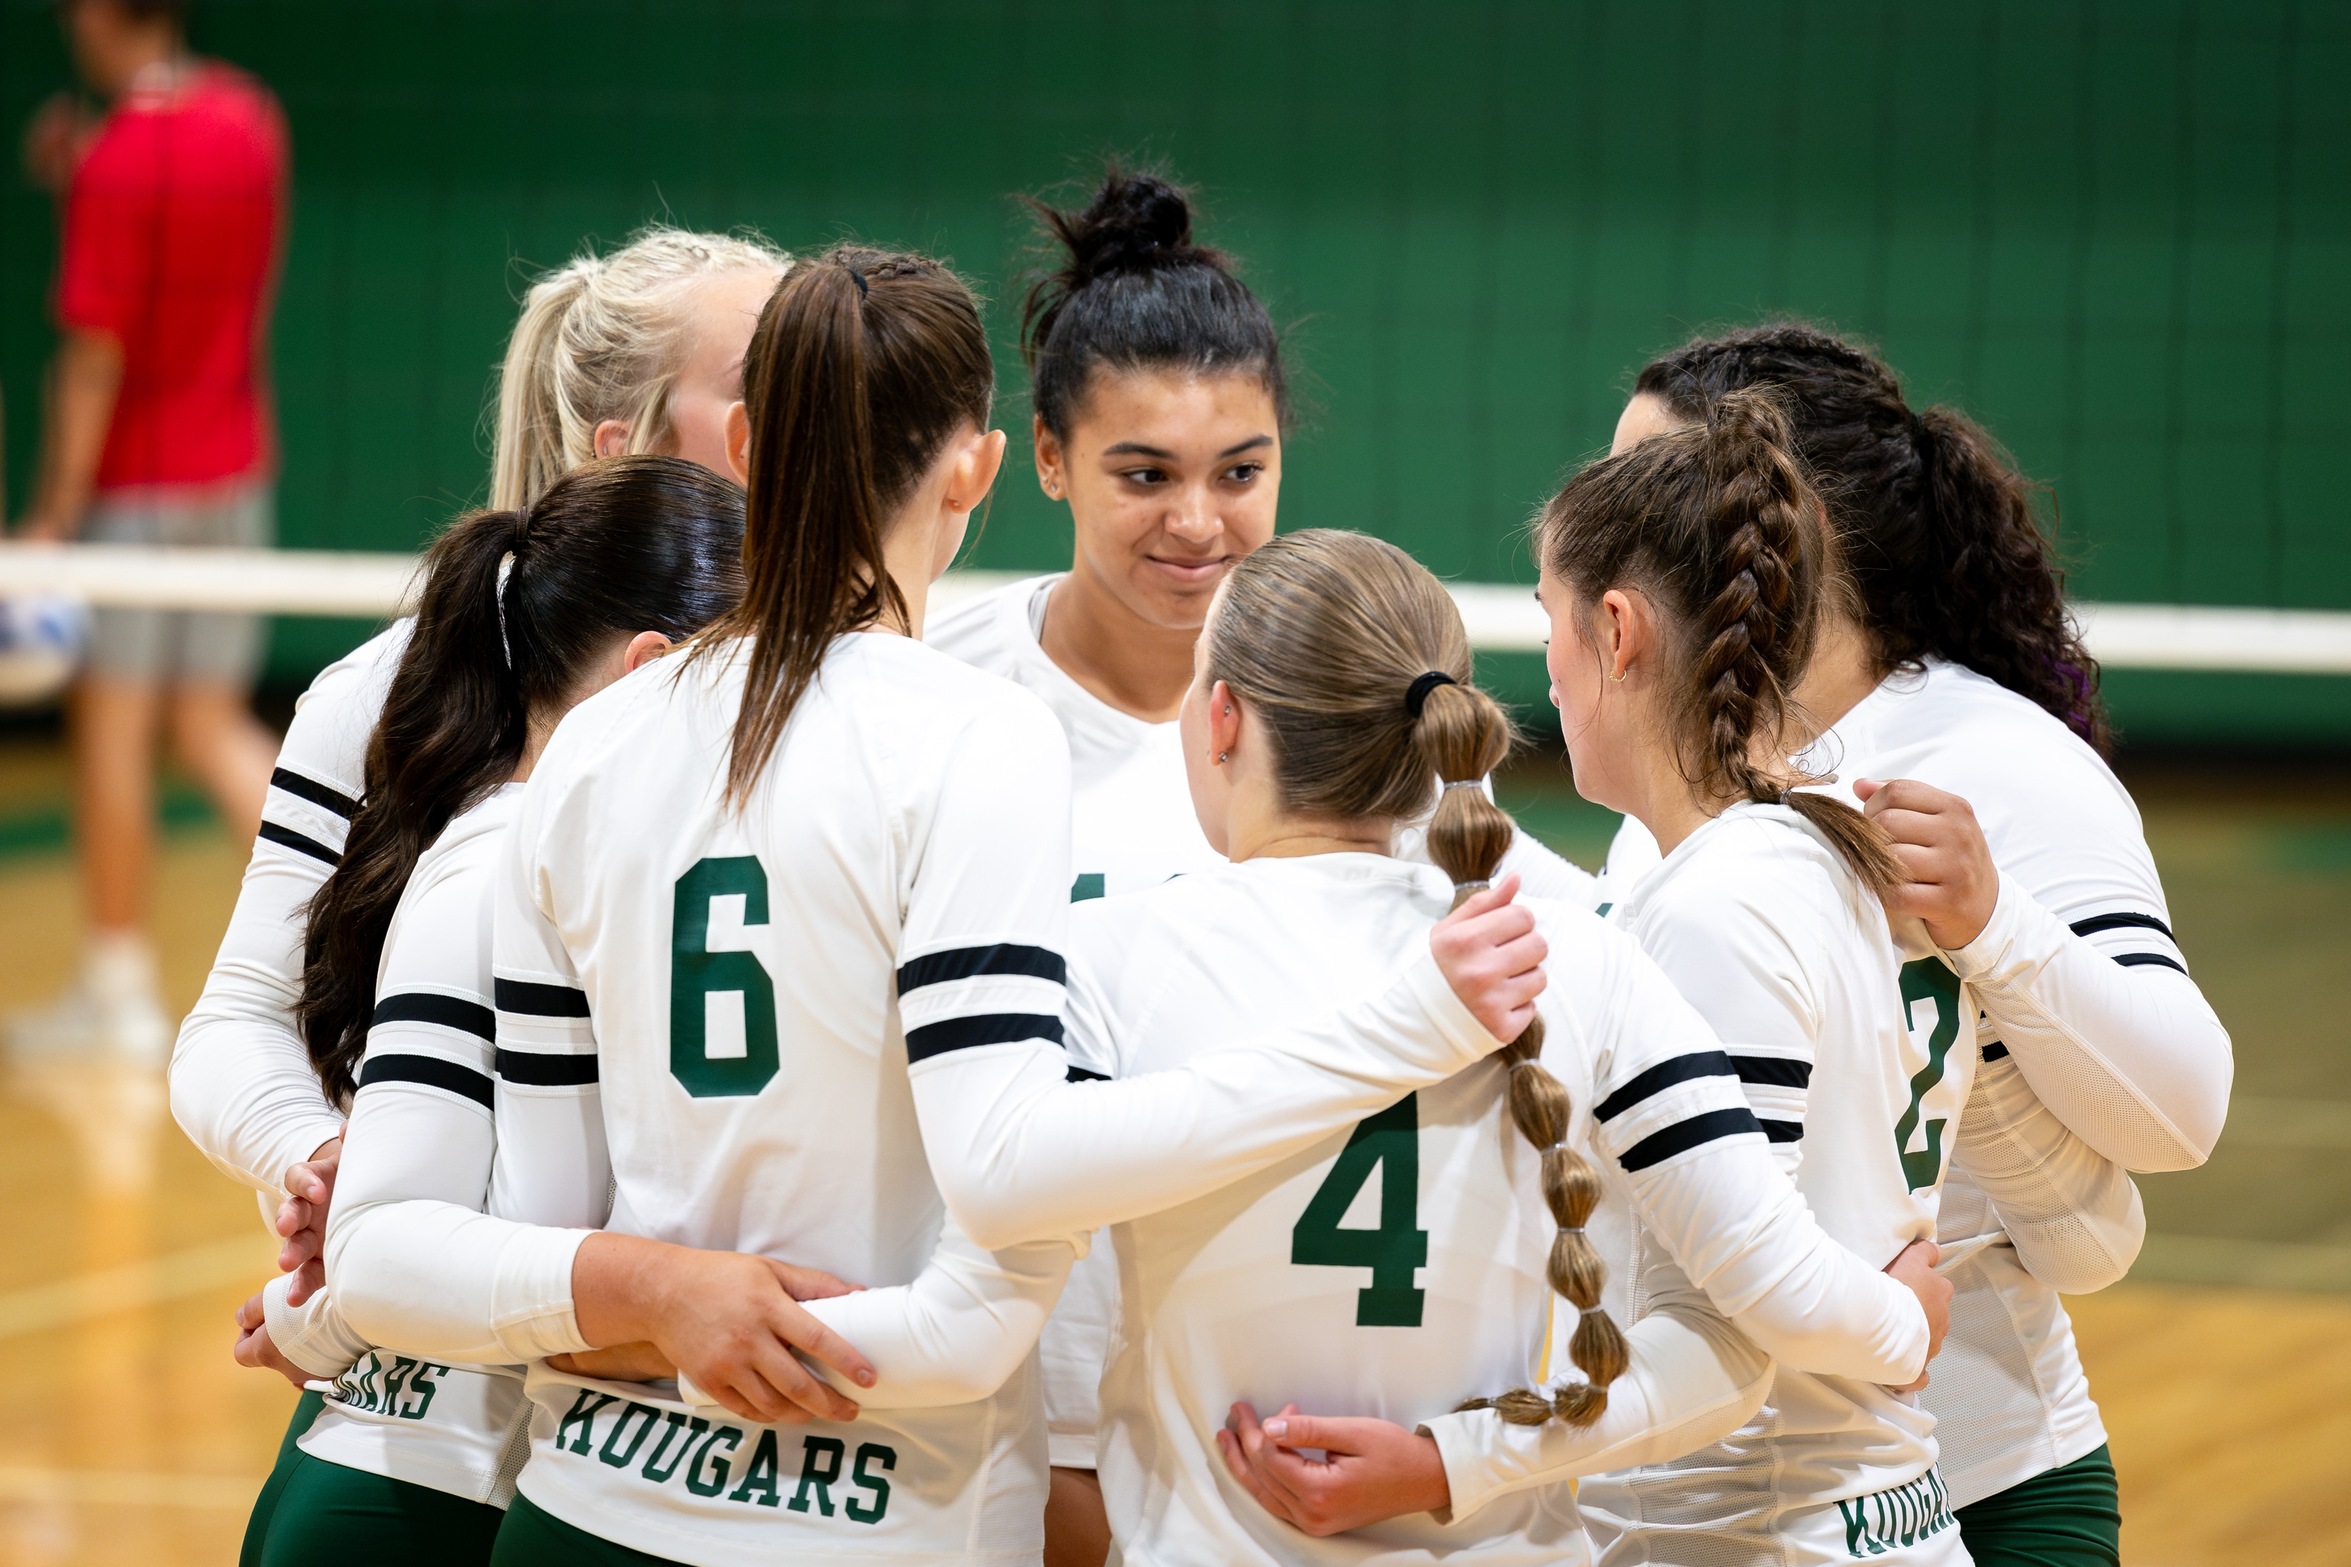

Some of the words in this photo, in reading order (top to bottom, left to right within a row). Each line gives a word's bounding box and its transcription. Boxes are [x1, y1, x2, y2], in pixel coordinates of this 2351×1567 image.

[670, 855, 780, 1098] 6
[1894, 956, 1961, 1195] 2
[1291, 1090, 1429, 1327] 4
[556, 1388, 897, 1525] KOUGARS
